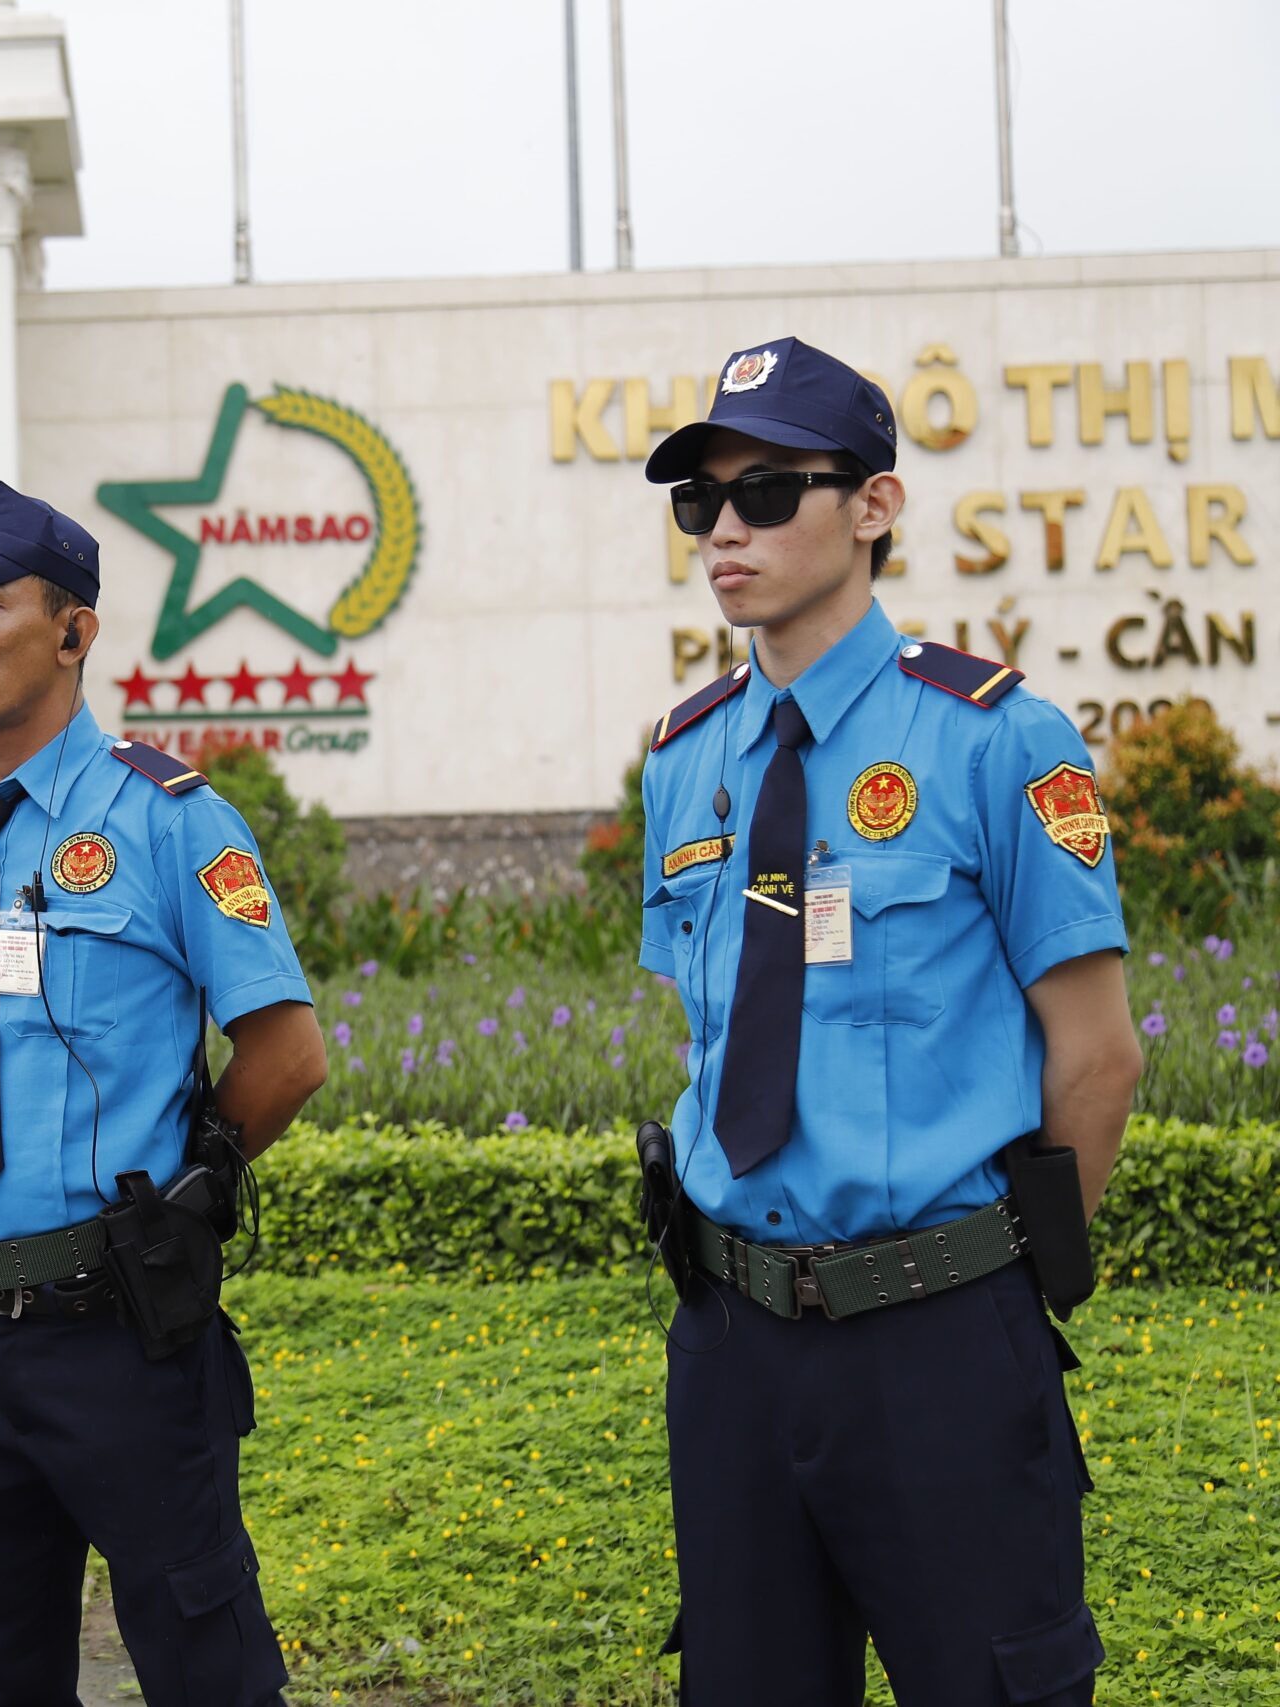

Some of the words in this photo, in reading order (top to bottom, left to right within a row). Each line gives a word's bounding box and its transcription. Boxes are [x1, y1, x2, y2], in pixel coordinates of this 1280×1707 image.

[550, 375, 720, 462] KH
[1005, 357, 1191, 463] THỊ
[953, 484, 1257, 574] STAR
[1106, 589, 1256, 669] CẦN
[1077, 697, 1212, 745] 20
[860, 825, 900, 837] SECURITY
[700, 841, 724, 858] CẢN
[757, 873, 768, 882] AN
[770, 873, 788, 882] NINH
[61, 881, 97, 892] SECURITY
[751, 881, 778, 895] CẢNH
[781, 881, 795, 897] VỆ
